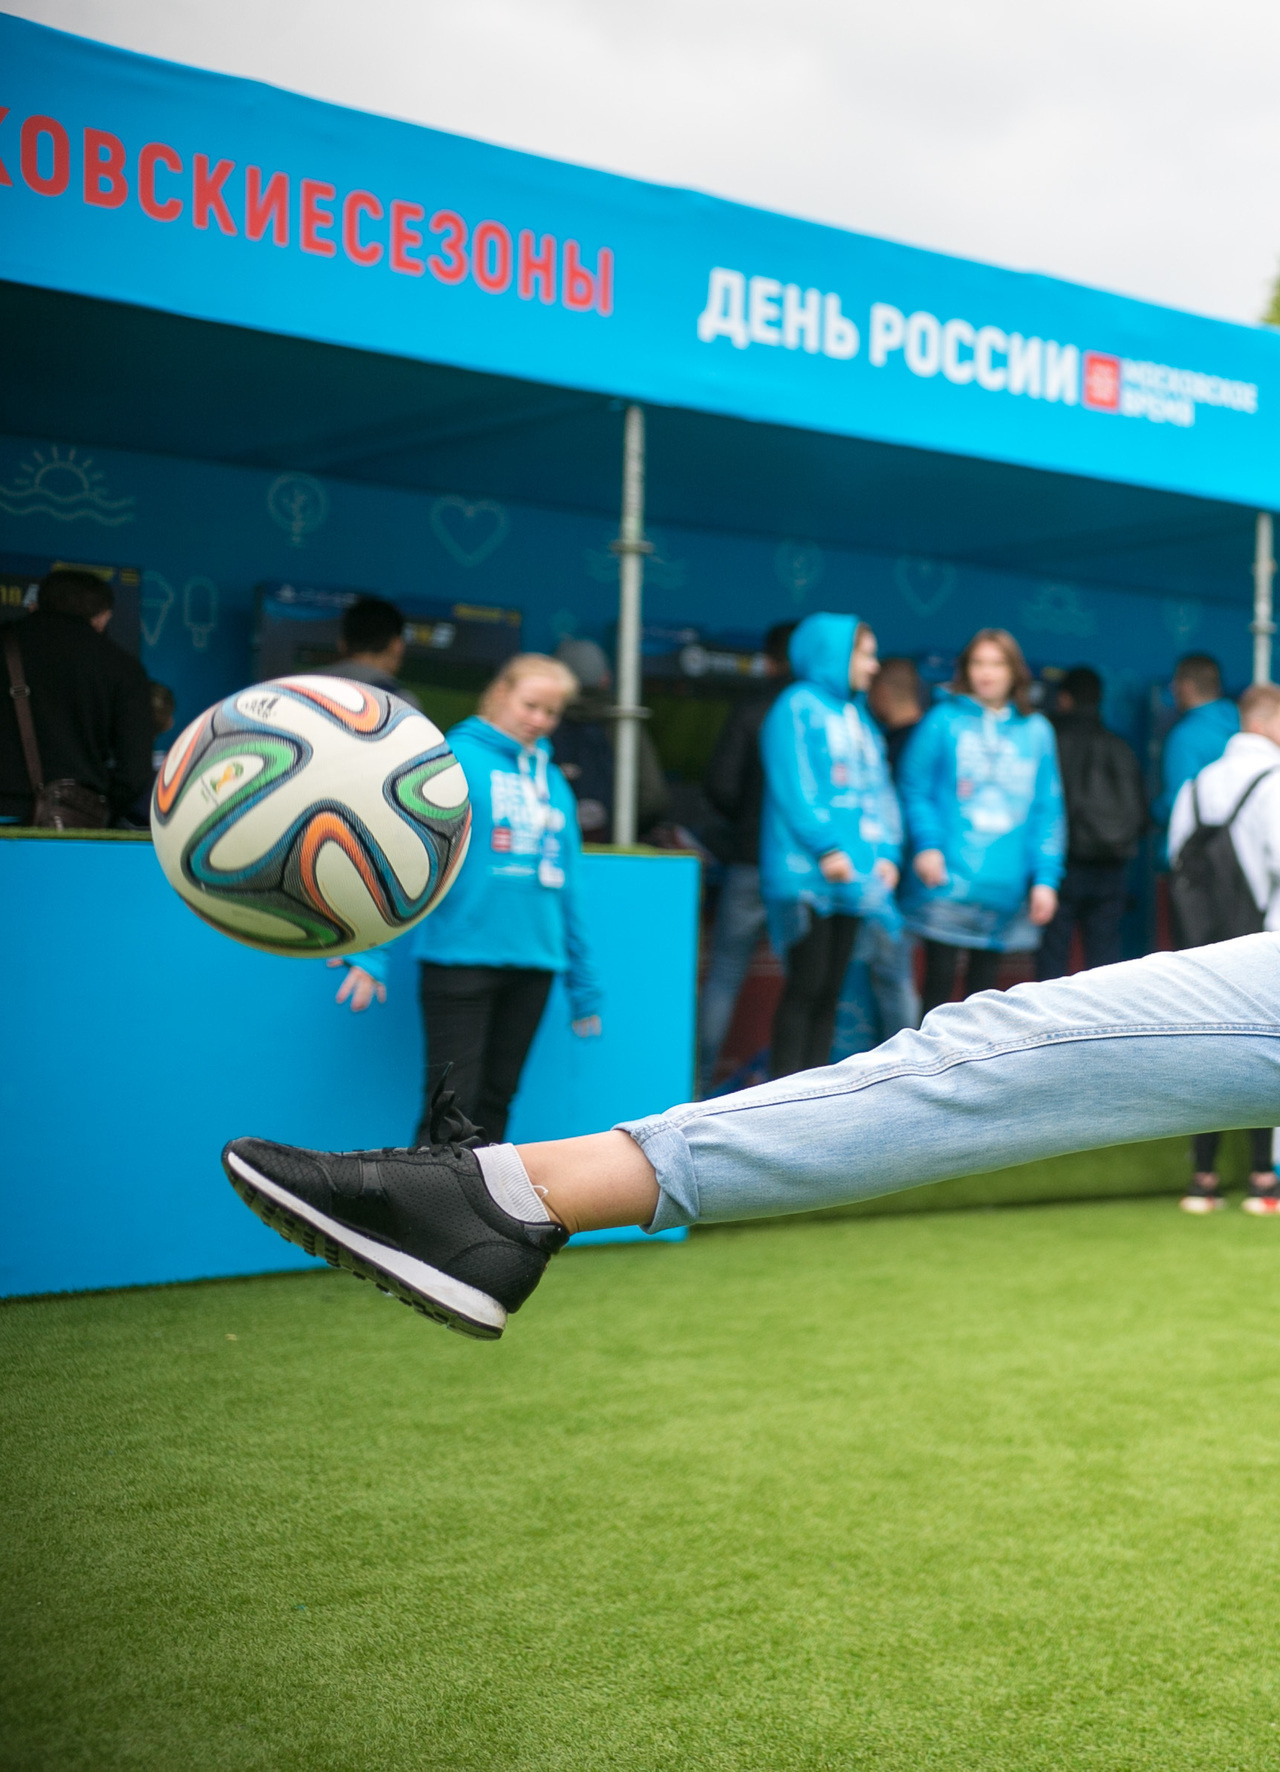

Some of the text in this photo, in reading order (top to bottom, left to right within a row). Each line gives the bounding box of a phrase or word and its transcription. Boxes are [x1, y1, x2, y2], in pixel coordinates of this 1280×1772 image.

[0, 106, 615, 317] ОВСКИЕСЕЗОНЫ
[698, 266, 1080, 406] ДЕНЬ РОССИИ
